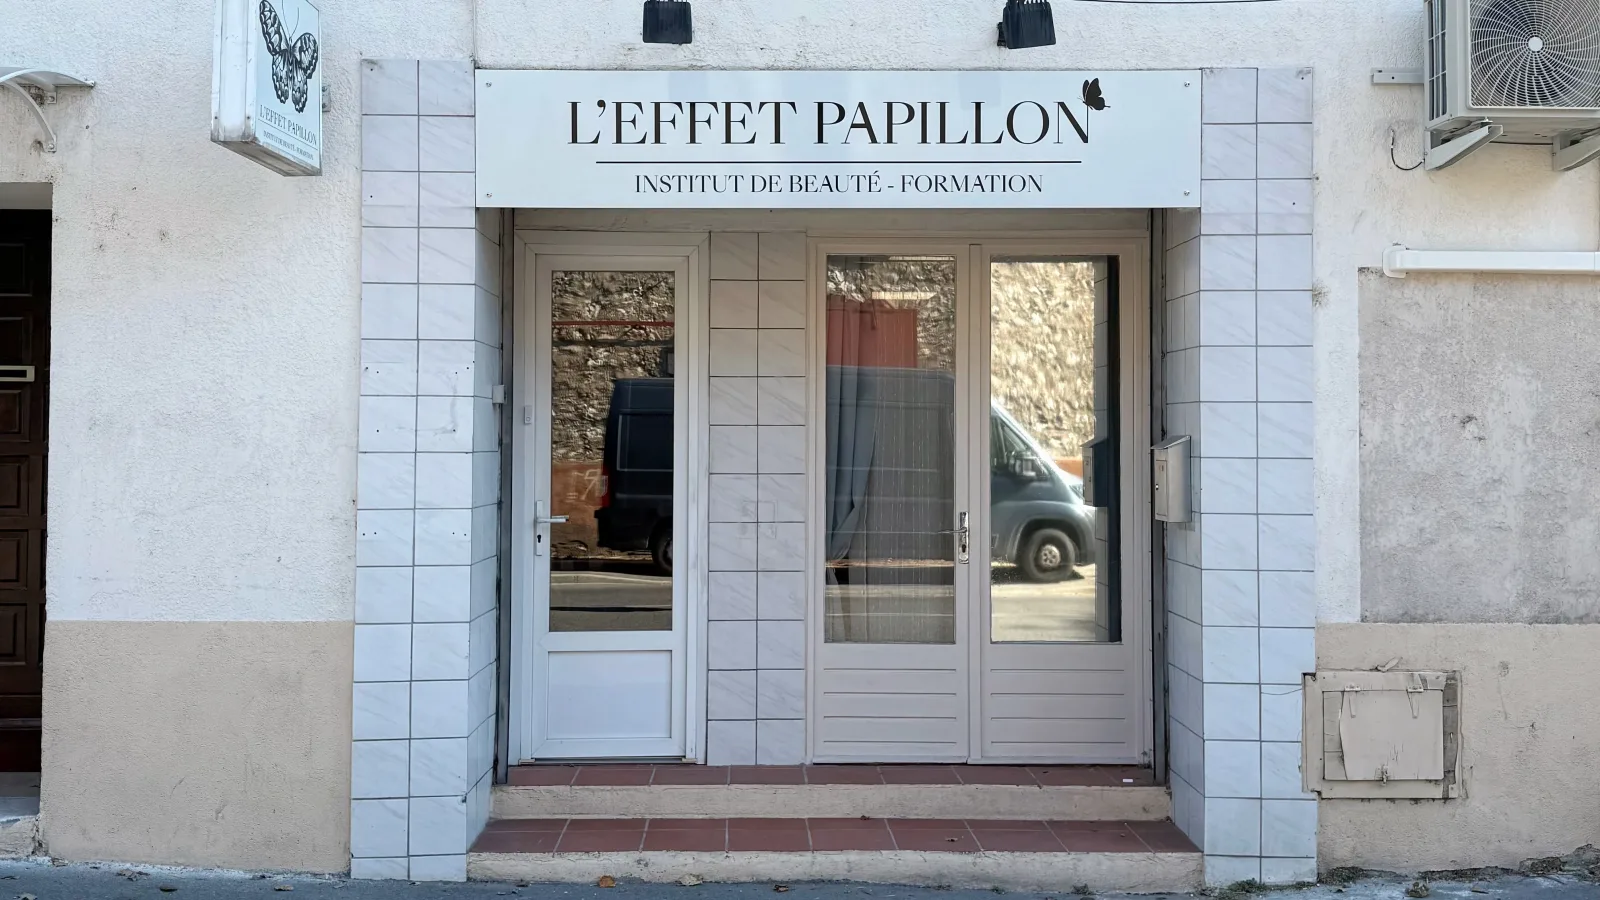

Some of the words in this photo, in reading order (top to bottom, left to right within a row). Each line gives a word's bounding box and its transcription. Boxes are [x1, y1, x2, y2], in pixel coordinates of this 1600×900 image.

[259, 104, 287, 130] L'EFFET
[287, 119, 317, 146] PAPILLON
[567, 99, 798, 145] L'EFFET
[813, 100, 1090, 145] PAPILLON
[635, 174, 745, 194] INSTITUT
[750, 174, 783, 194] DE
[789, 170, 882, 194] BEAUTÉ
[901, 174, 1043, 194] FORMATION
